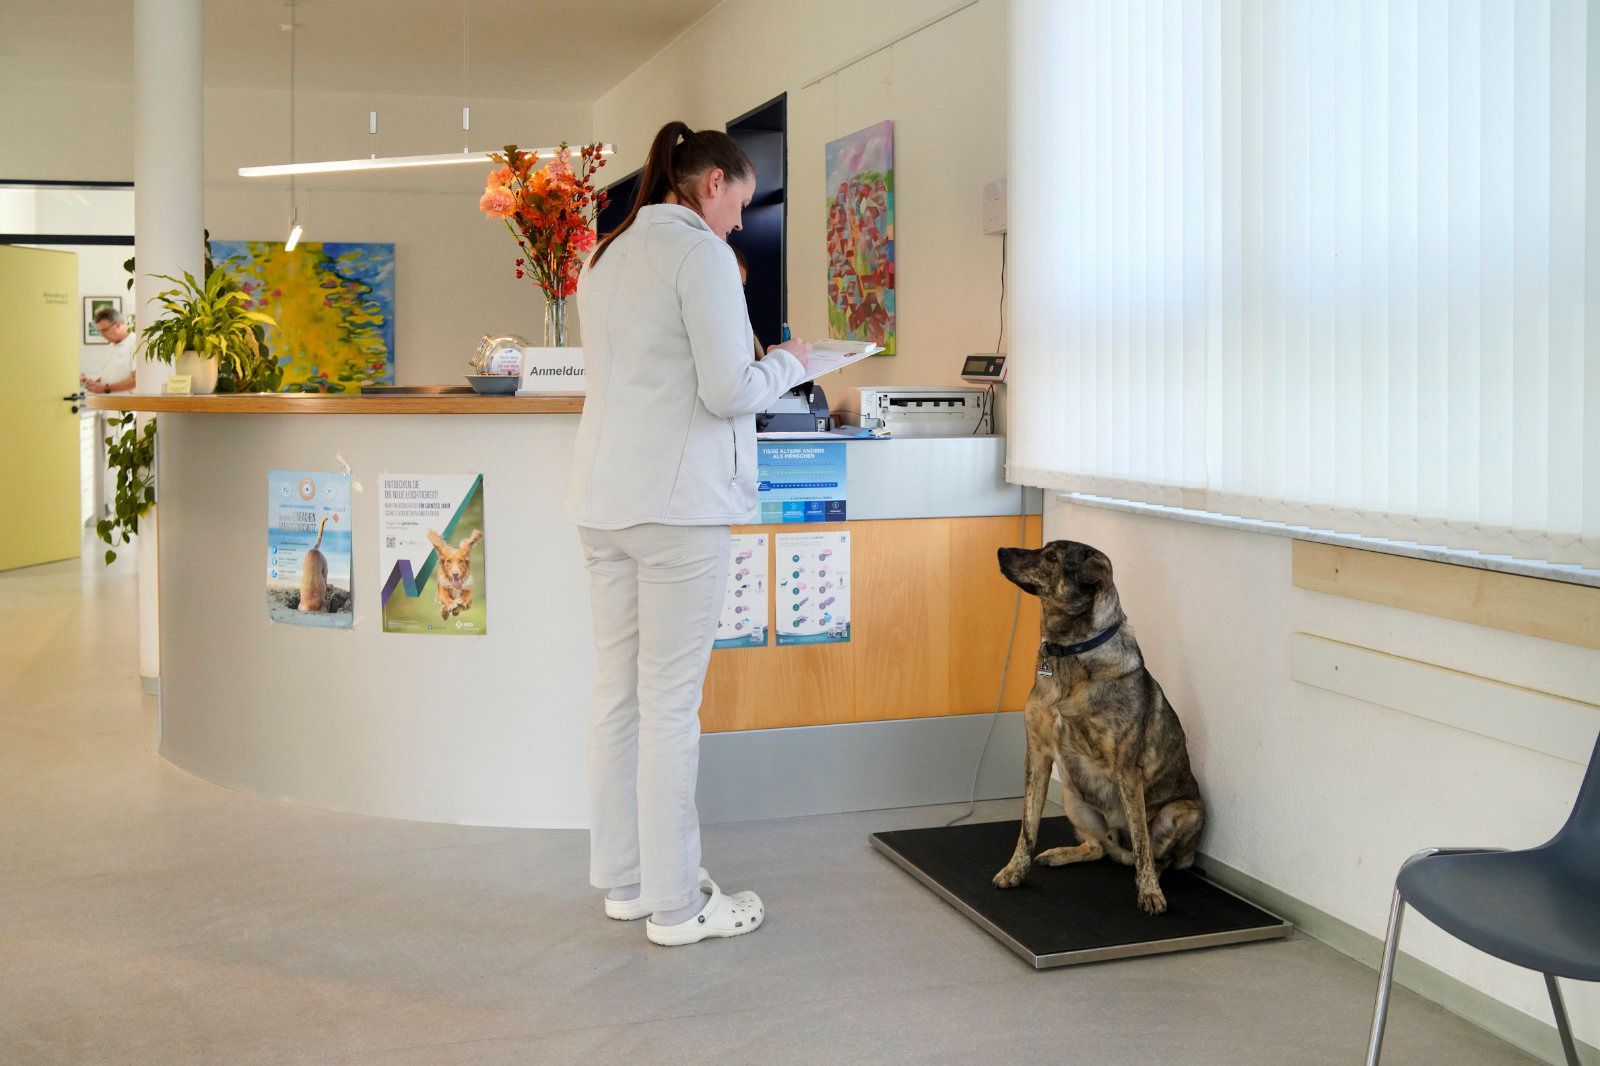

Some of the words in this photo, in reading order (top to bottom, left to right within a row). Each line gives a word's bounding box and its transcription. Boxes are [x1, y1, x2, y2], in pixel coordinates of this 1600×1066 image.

[530, 366, 585, 376] Anmeldun
[384, 480, 412, 489] ENTDECKEN
[384, 490, 392, 499] DIE
[392, 490, 406, 499] NEUE
